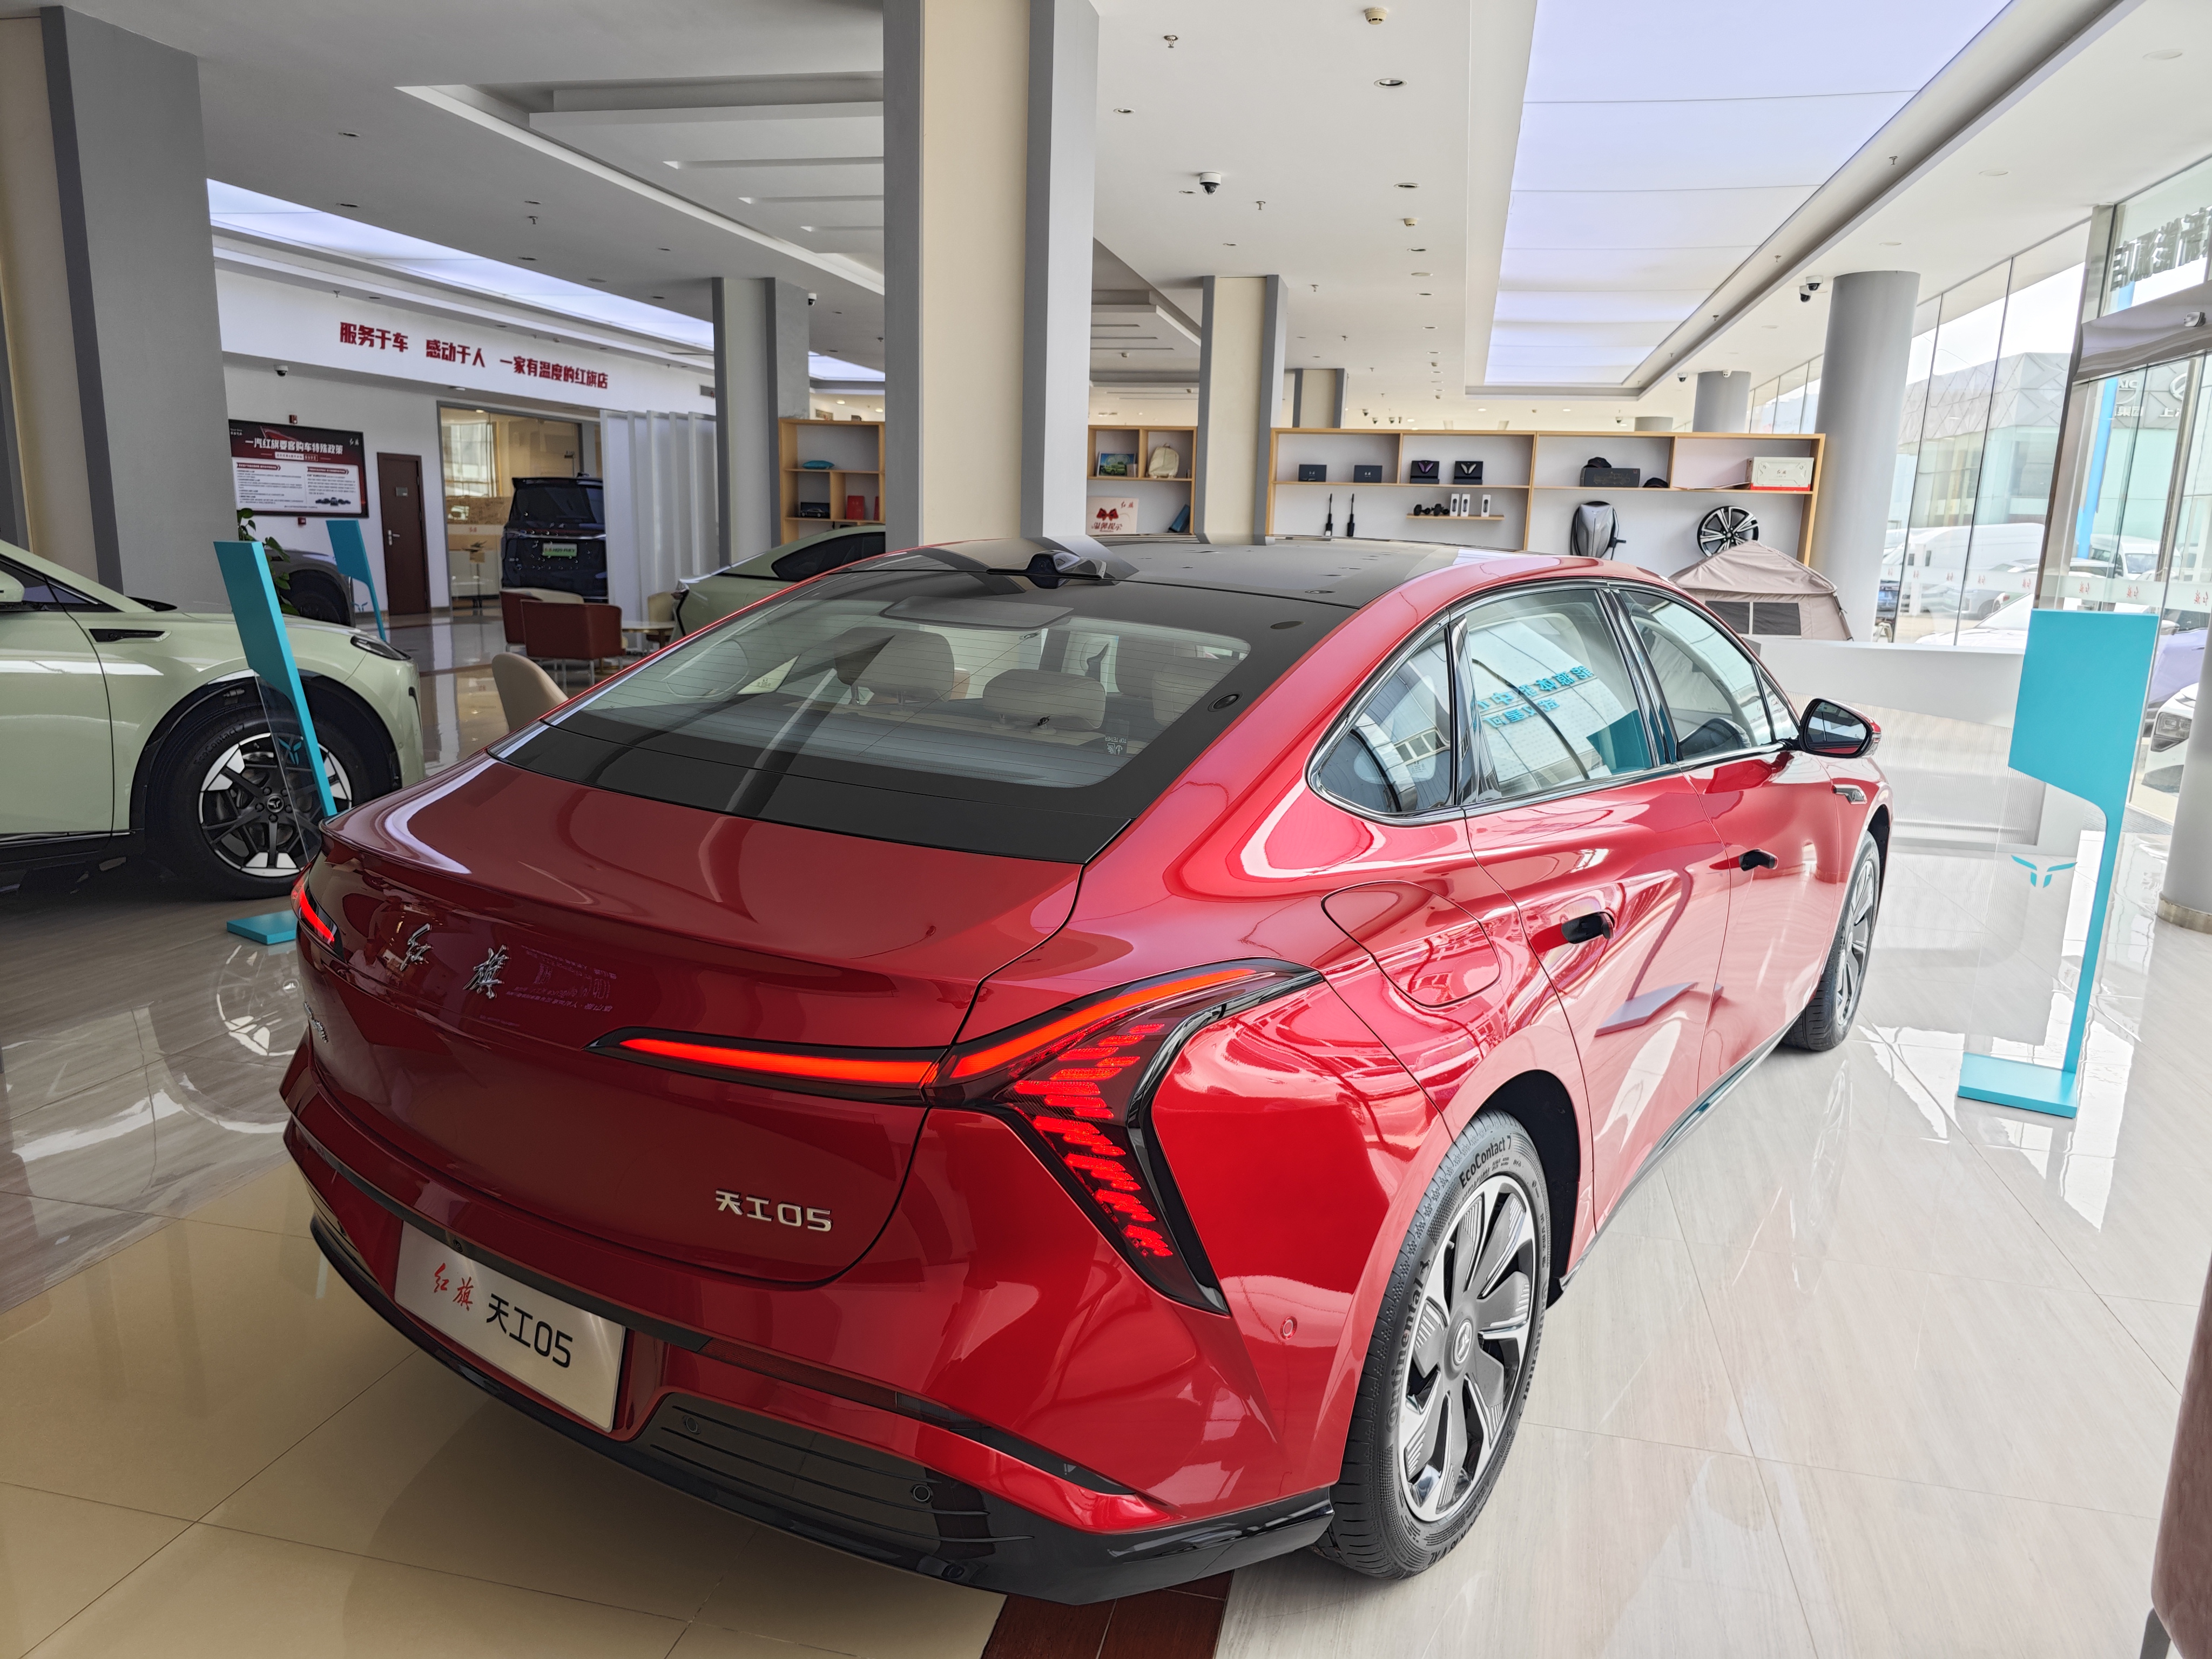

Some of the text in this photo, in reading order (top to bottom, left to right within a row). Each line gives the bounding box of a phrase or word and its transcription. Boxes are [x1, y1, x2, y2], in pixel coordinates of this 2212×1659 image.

[340, 322, 608, 389] 服务于车 感动于人 一家有温度的红旗店
[1459, 1134, 1512, 1189] EcoContact 7
[715, 1188, 832, 1232] 天工05
[434, 1262, 573, 1368] 红旗 天工05
[1384, 1277, 1424, 1433] Continental
